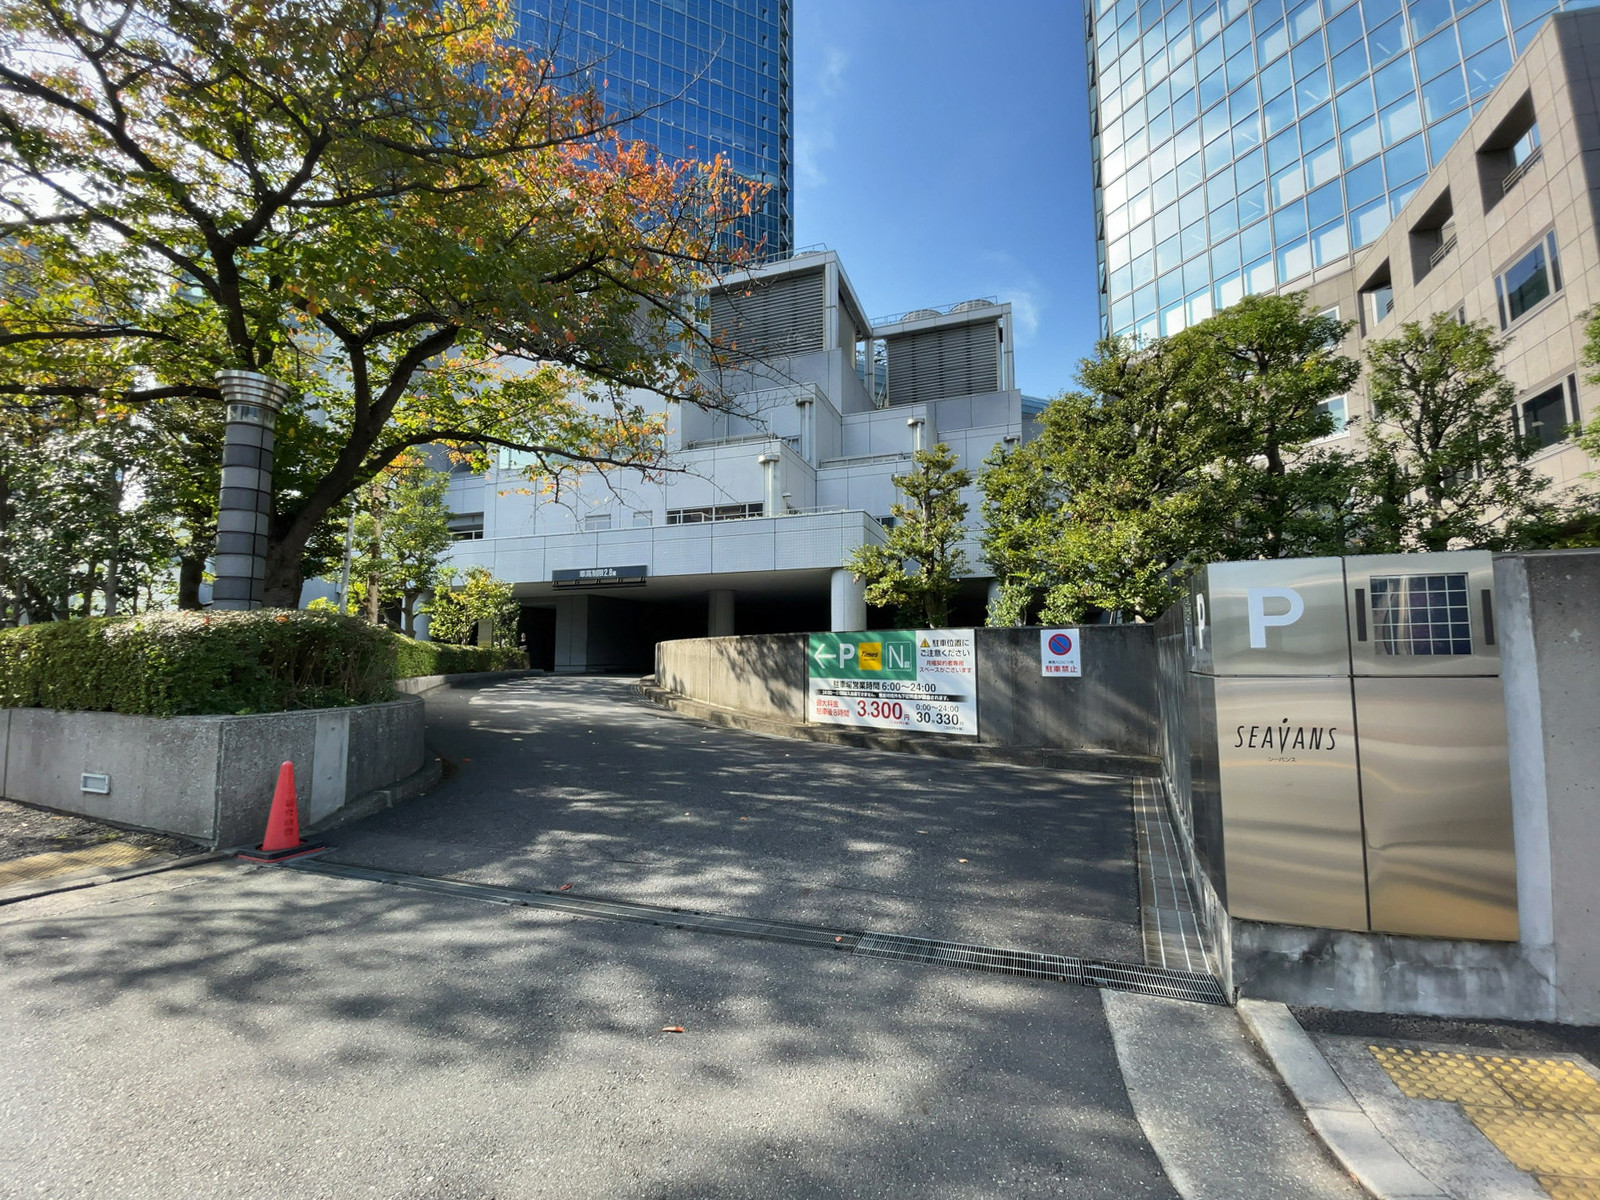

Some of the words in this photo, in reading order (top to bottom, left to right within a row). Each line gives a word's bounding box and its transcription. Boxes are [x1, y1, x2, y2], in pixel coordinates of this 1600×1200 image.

[1247, 587, 1305, 649] P
[932, 638, 970, 648] 駐車位置に
[839, 643, 855, 669] P
[920, 649, 970, 657] ご注意ください
[1045, 665, 1077, 673] 駐車禁止
[816, 698, 839, 708] 最大料金
[1234, 717, 1337, 754] SEAVANS
